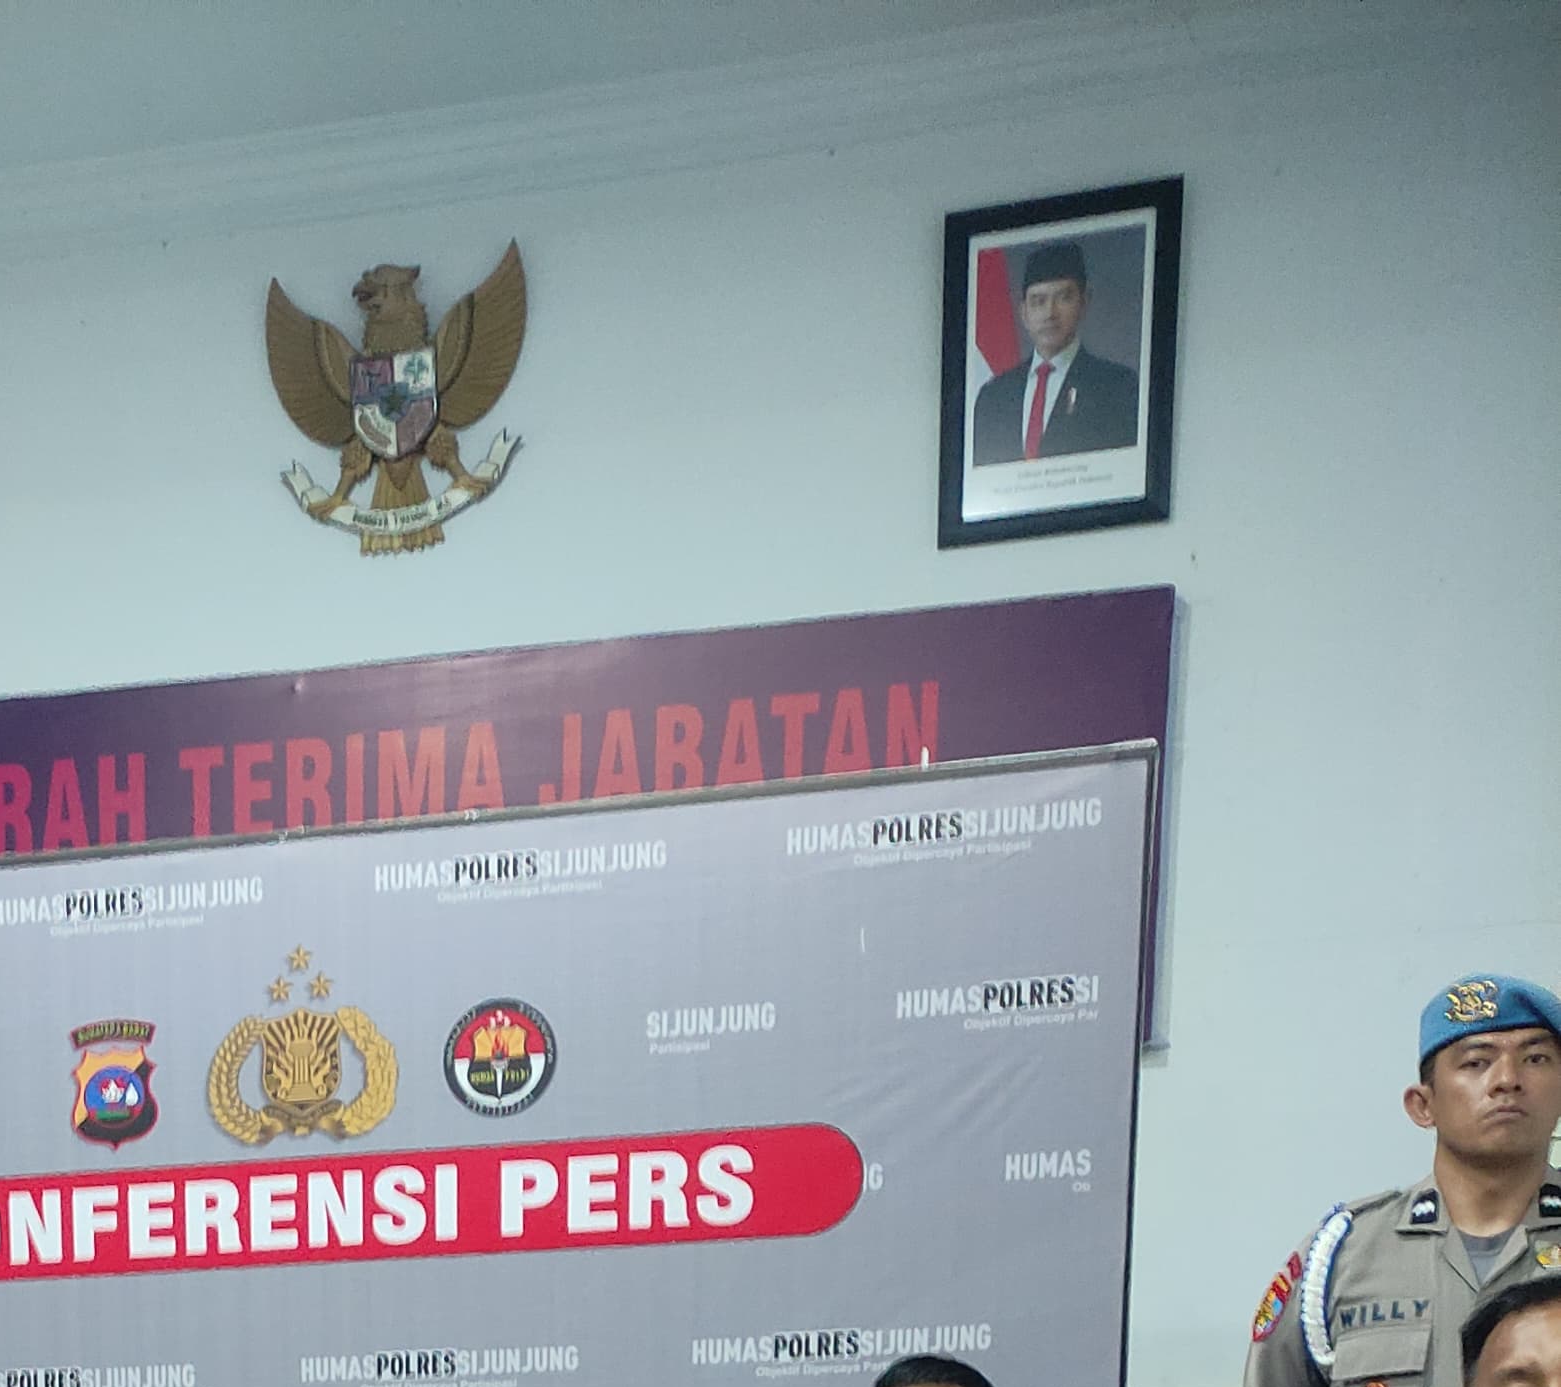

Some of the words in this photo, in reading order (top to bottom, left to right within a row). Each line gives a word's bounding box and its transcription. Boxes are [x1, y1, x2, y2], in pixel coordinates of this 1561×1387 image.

[179, 723, 507, 841] TERIMA
[539, 680, 941, 805] JABATAN
[645, 1001, 776, 1039] SIJUNJUNG
[1005, 1149, 1092, 1181] HUMAS
[500, 1144, 755, 1238] PERS
[1340, 1299, 1429, 1328] WILLY
